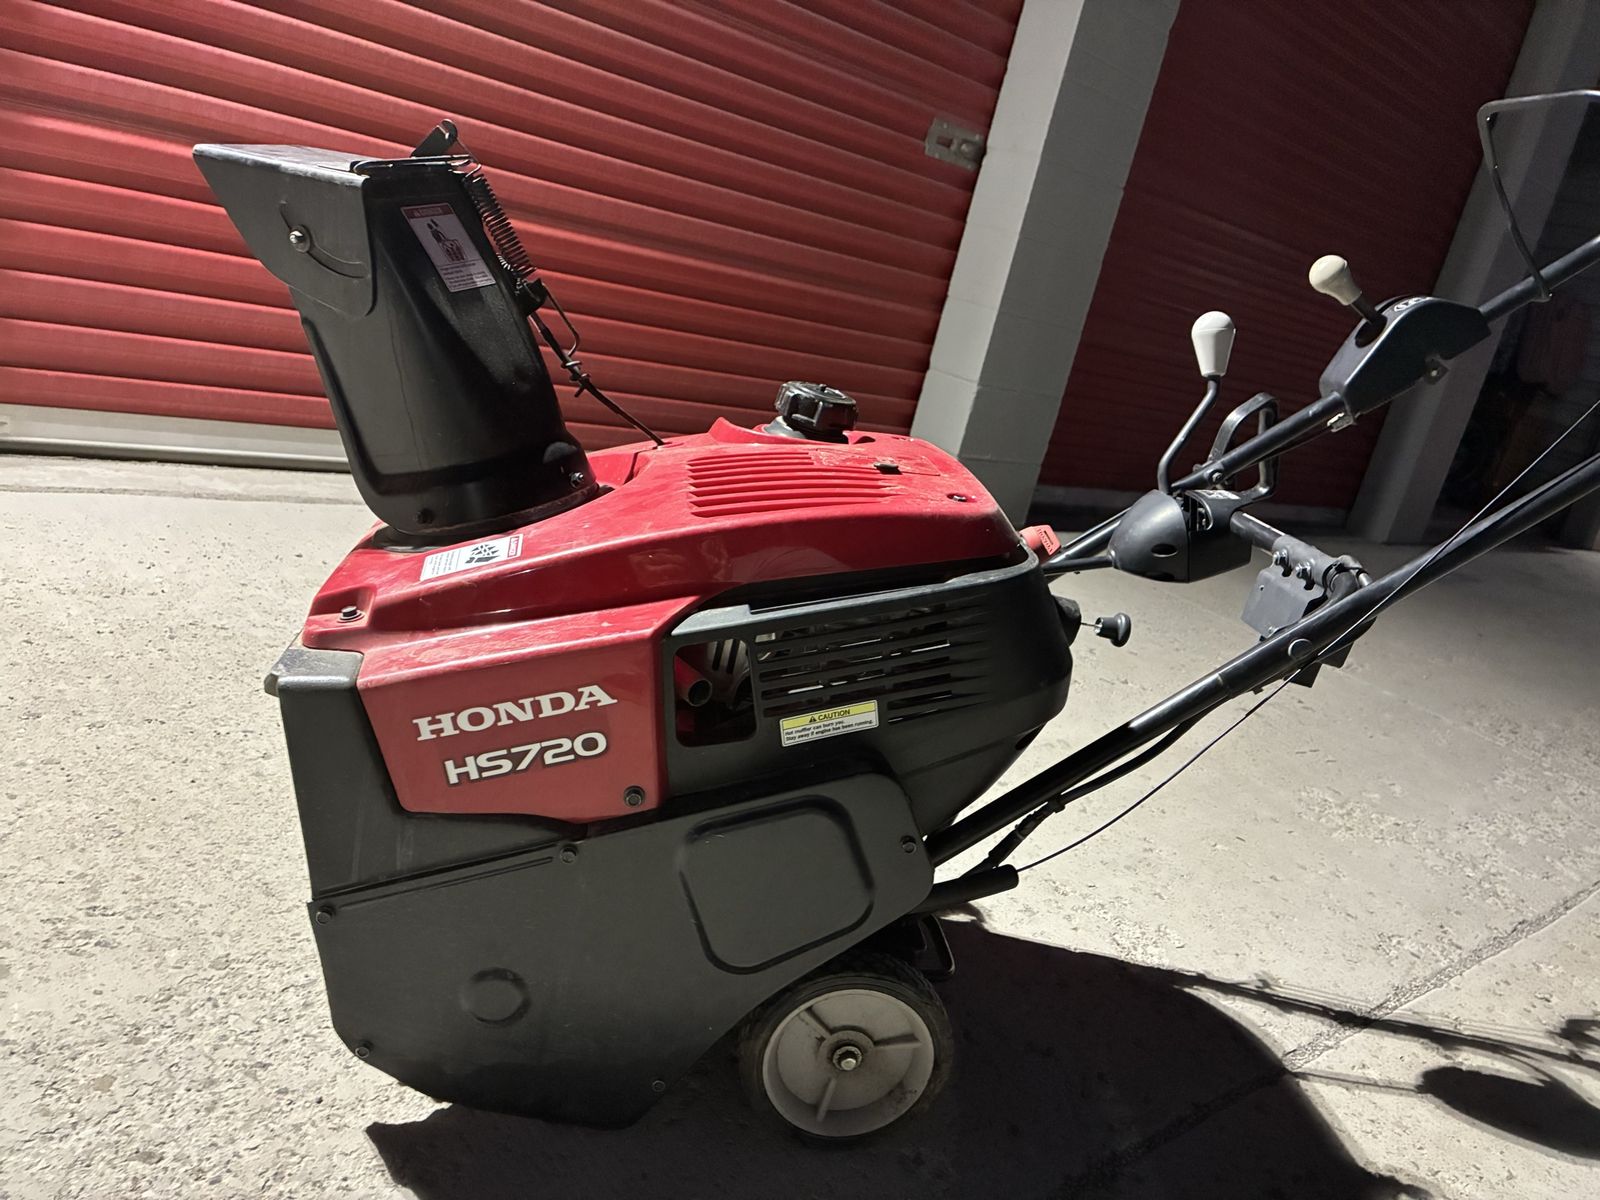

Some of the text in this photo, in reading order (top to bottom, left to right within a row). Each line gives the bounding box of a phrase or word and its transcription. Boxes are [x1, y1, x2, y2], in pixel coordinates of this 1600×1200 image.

[412, 684, 617, 741] HONDA
[817, 709, 851, 721] CAUTION
[444, 732, 607, 785] HS720
